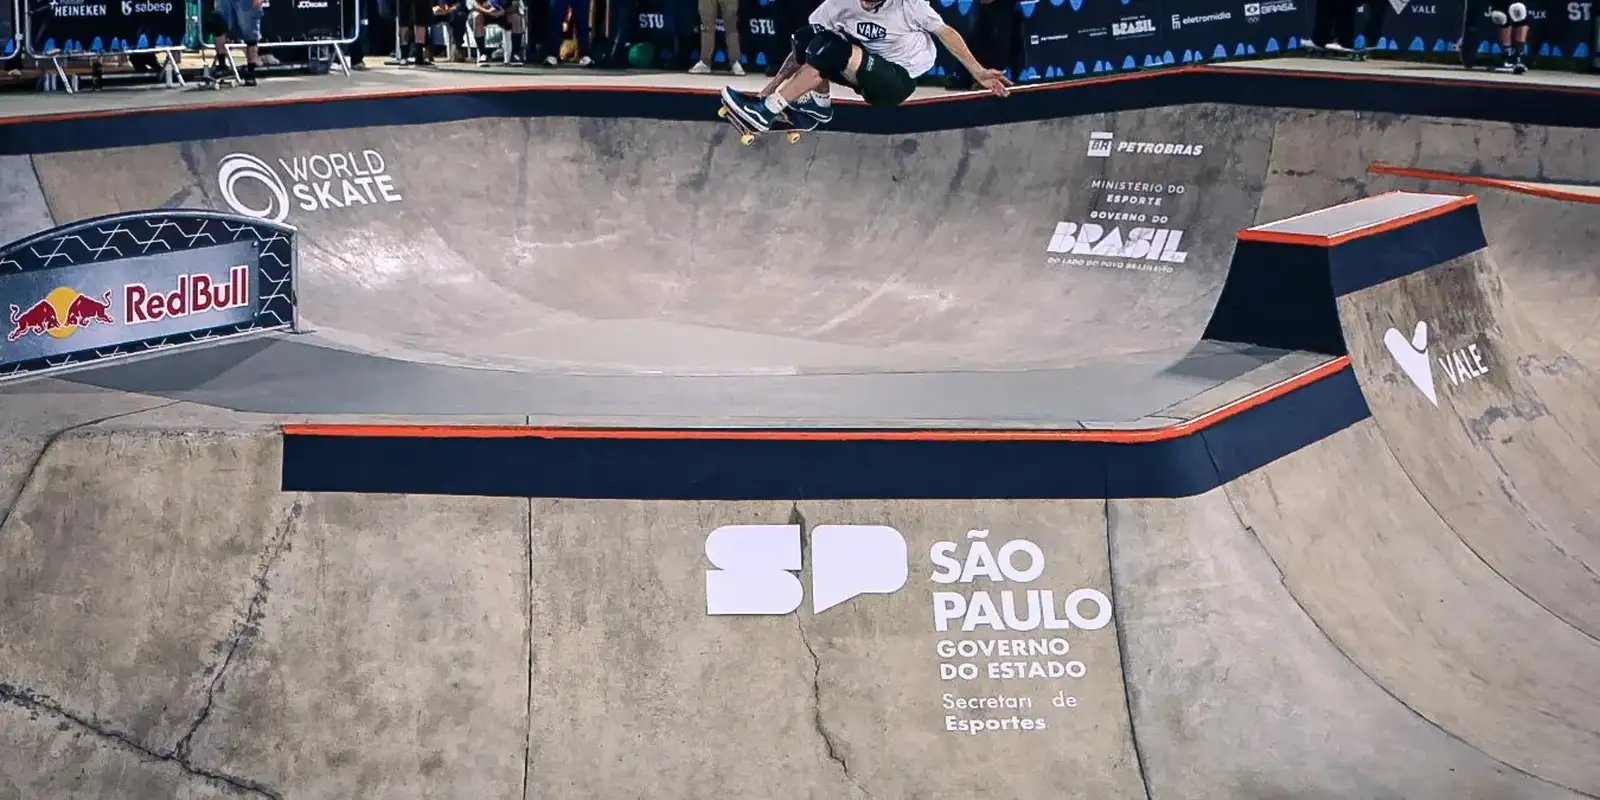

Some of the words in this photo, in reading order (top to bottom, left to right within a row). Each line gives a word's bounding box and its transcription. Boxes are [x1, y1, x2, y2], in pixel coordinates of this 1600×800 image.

[54, 4, 107, 16] HEINEKEN
[135, 0, 172, 13] sabesp
[1411, 5, 1436, 14] VALE
[1567, 2, 1592, 20] ST
[639, 13, 664, 28] STU
[1182, 11, 1231, 25] eletromidia
[858, 23, 885, 38] VANS
[1112, 19, 1156, 36] BRASIL
[1117, 141, 1204, 156] PETROBRAS
[278, 149, 385, 182] WORLD
[292, 175, 402, 212] SKATE
[1091, 179, 1162, 193] MINISTÉRIO
[1167, 184, 1185, 194] DO
[1106, 194, 1162, 206] ESPORTE
[1089, 210, 1146, 222] GOVERNO
[1152, 214, 1168, 224] DO
[1046, 221, 1188, 263] BRASIL
[124, 274, 187, 325] Red
[190, 264, 250, 314] Bull
[1438, 343, 1489, 387] VALE
[930, 529, 1045, 584] SÃO
[933, 589, 1113, 633] PAULO
[936, 638, 1071, 659] GOVERNO
[940, 662, 979, 681] DO
[987, 660, 1087, 680] ESTADO
[1052, 690, 1078, 708] de
[945, 715, 1047, 736] Esportes
